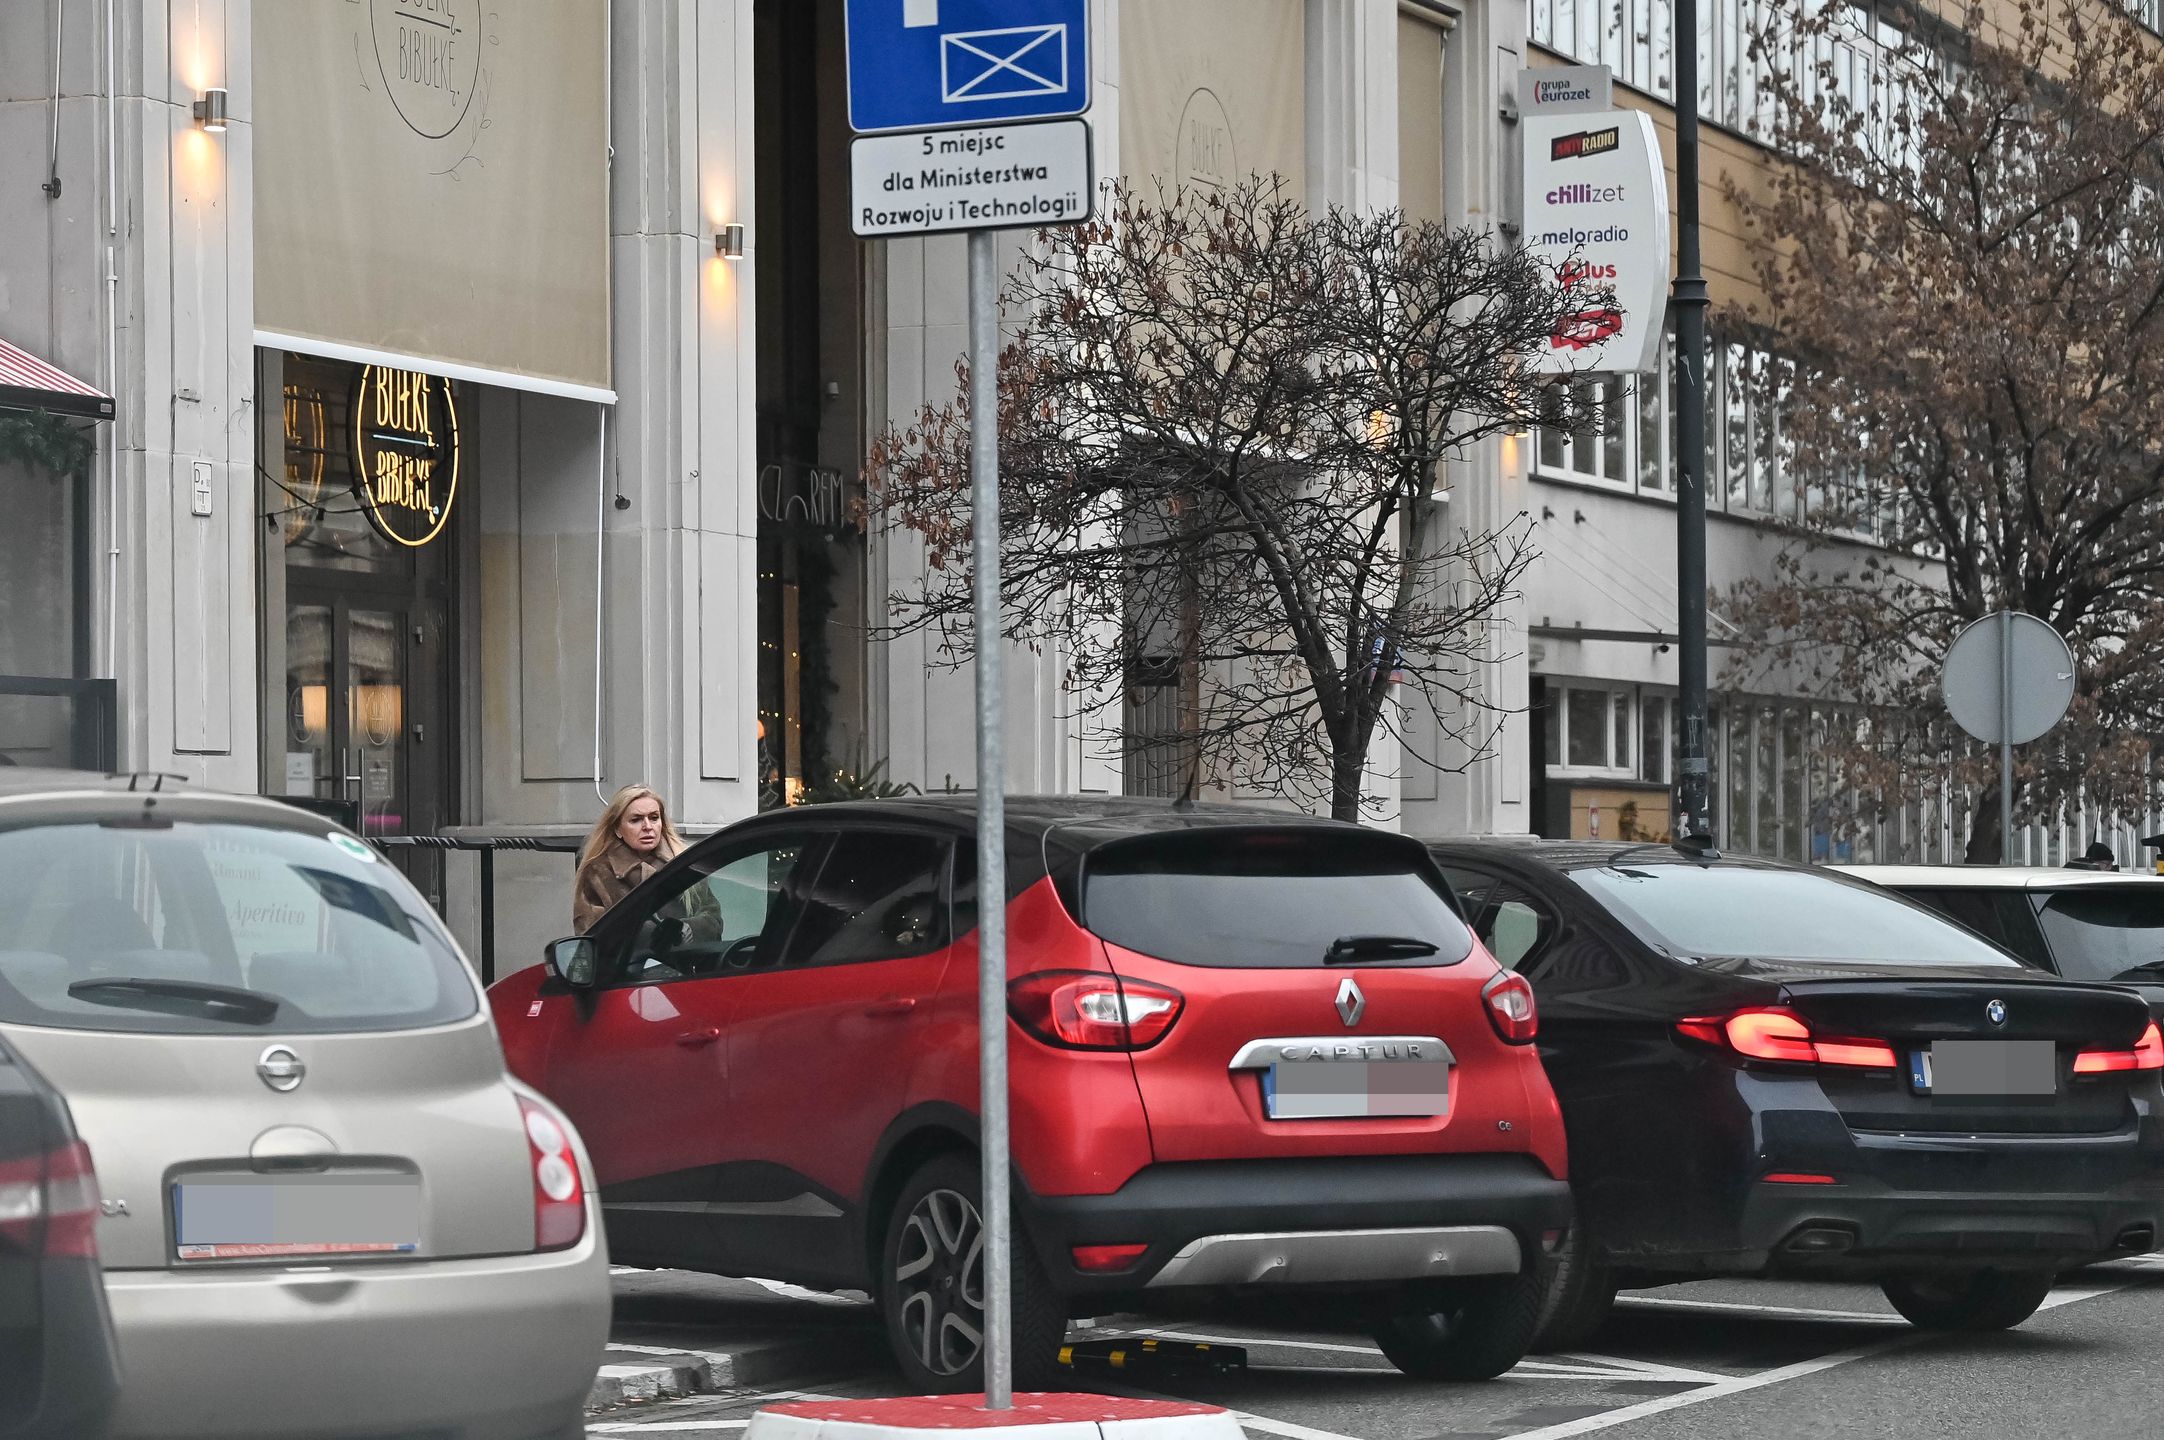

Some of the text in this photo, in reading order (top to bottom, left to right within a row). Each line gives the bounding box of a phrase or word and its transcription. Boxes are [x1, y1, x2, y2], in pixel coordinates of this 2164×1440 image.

[1541, 80, 1570, 91] grupa
[1541, 88, 1591, 102] eurozet
[923, 133, 1005, 156] 5 miejsc
[883, 164, 1048, 191] dla Ministerstwa
[862, 192, 1078, 227] Rozwoju i Technologii
[1542, 225, 1629, 245] meloradio
[1279, 1044, 1423, 1061] CAPTUR
[1914, 1073, 1924, 1083] PL
